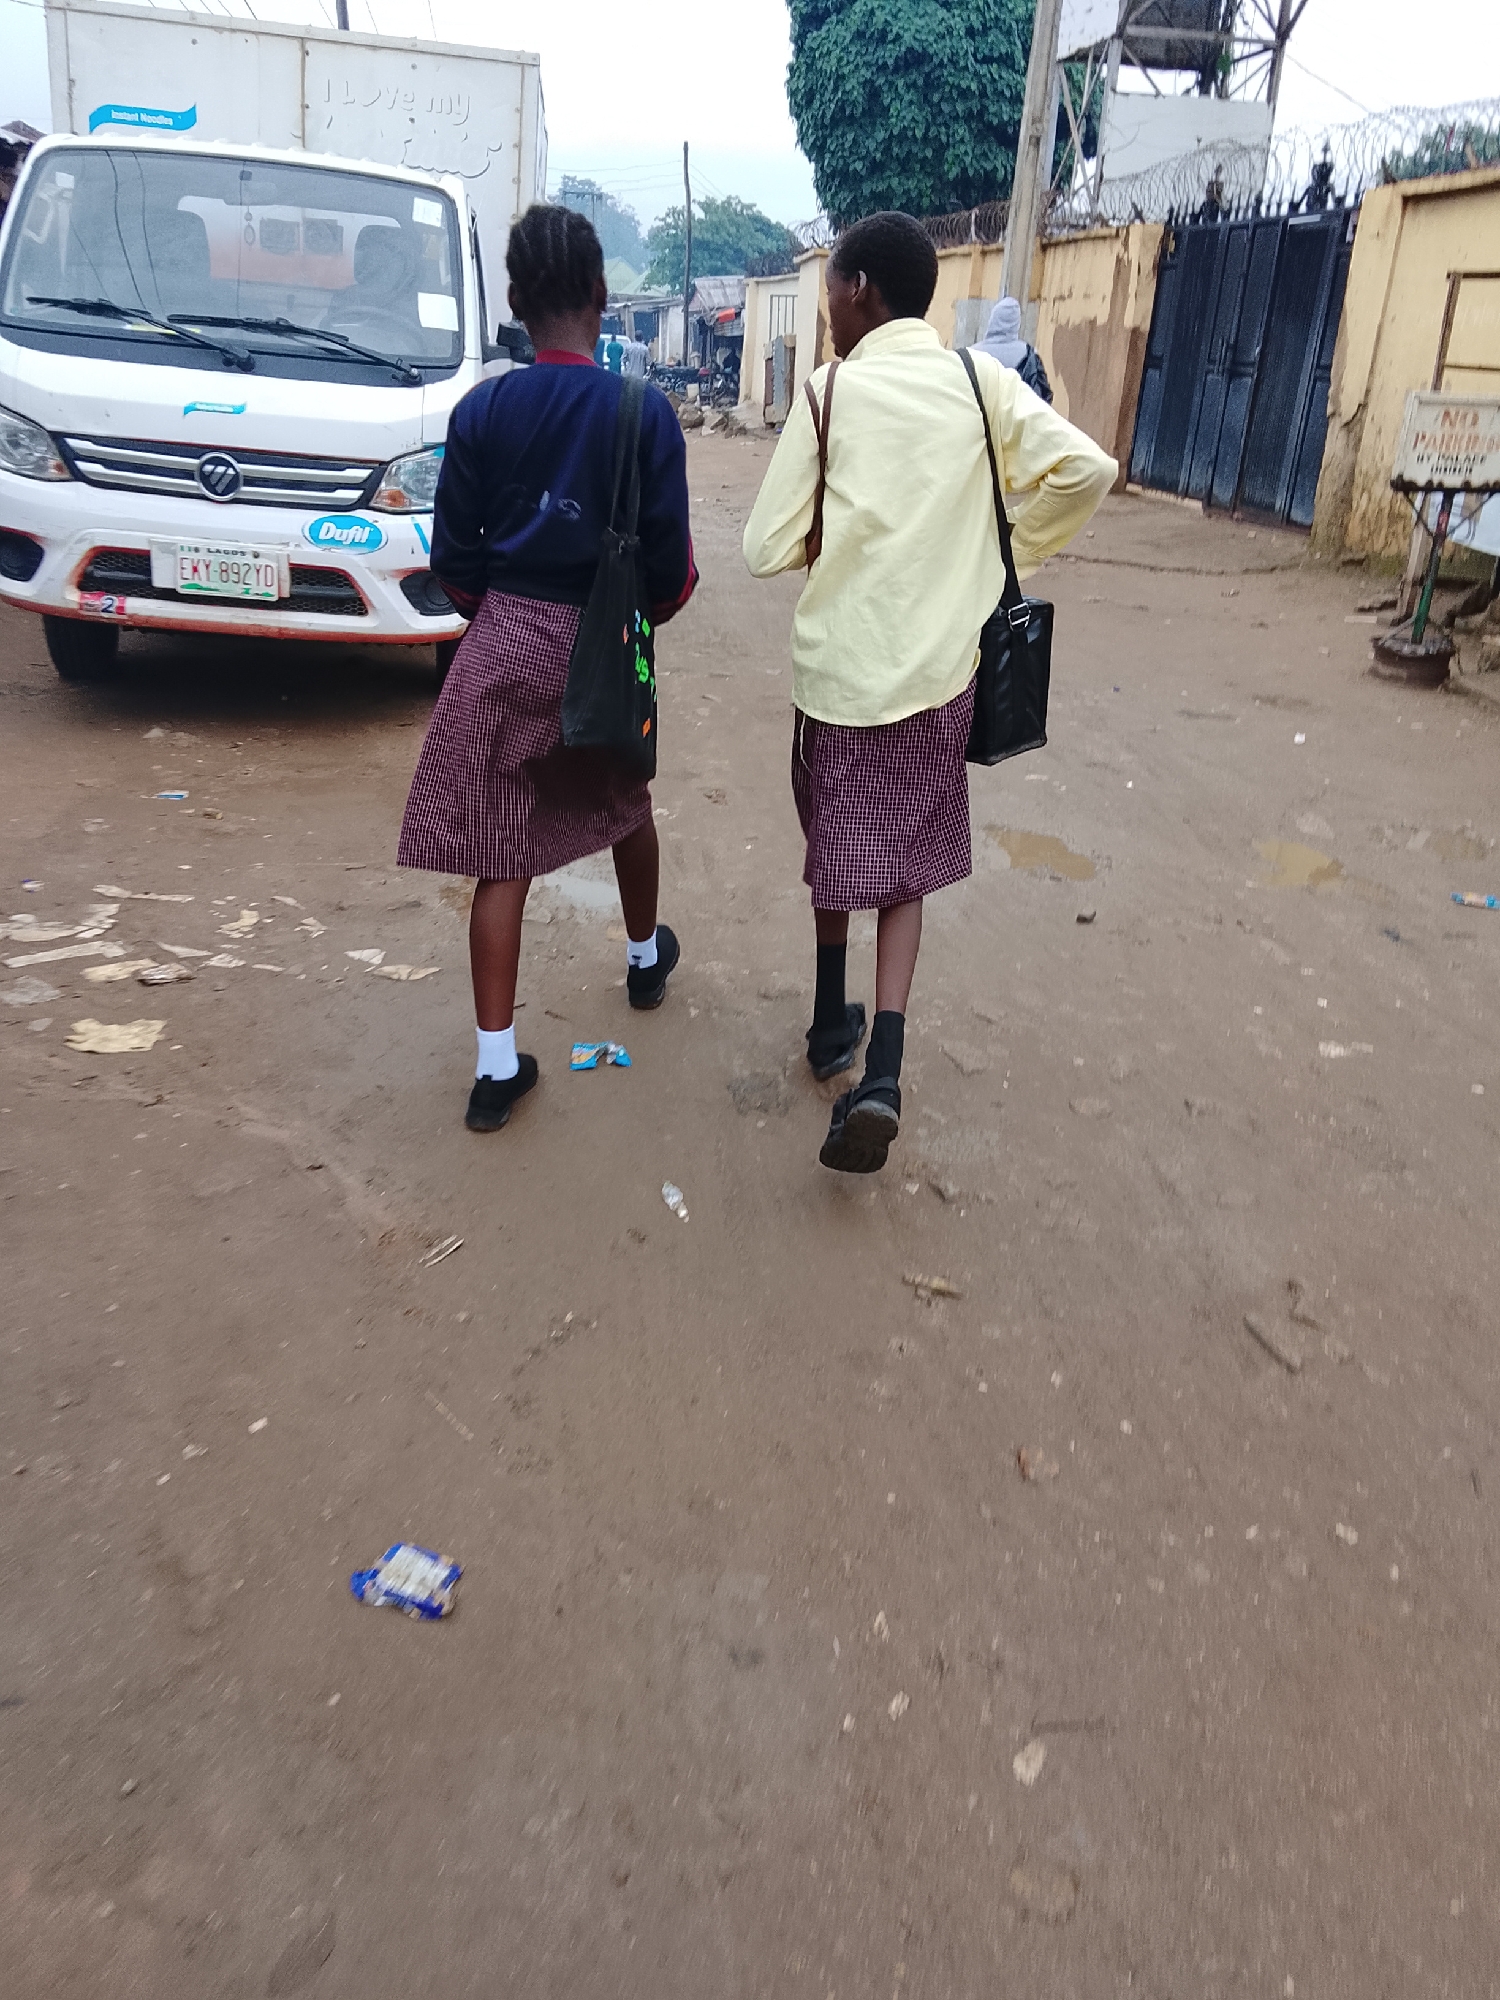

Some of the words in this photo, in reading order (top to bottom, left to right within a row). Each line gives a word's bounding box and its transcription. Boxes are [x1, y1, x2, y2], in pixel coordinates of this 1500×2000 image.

[1440, 408, 1480, 428] NO
[318, 521, 371, 545] Dufil
[206, 547, 247, 557] LAGOS
[100, 596, 114, 614] 2
